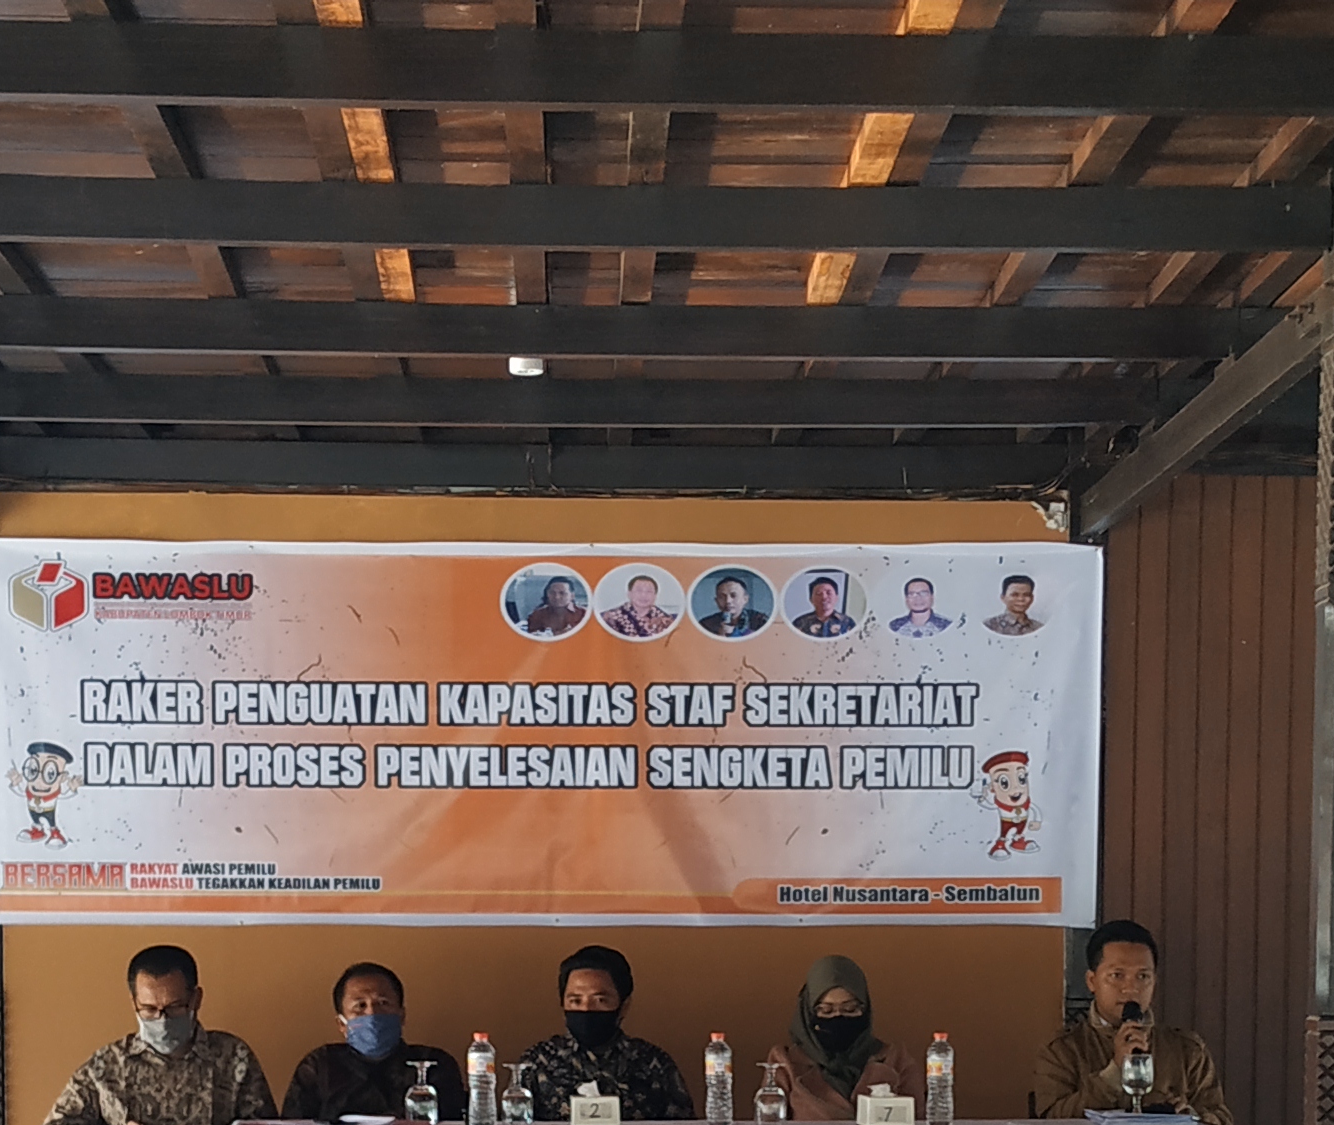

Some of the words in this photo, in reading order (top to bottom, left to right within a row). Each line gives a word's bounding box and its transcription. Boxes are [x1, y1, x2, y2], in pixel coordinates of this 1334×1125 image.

[93, 573, 253, 601] BAWASLU
[81, 680, 203, 723] RAKER
[212, 681, 427, 725] PENGUATAN
[438, 683, 636, 726] KAPASITAS
[645, 684, 735, 726] STAF
[742, 684, 979, 727] SEKRETARIAT
[84, 743, 214, 786] DALAM
[223, 744, 366, 788] PROSES
[375, 744, 638, 788] PENYELESAIAN
[646, 745, 831, 789] SENGKETA
[840, 746, 975, 789] PEMILU
[3, 862, 125, 889] BERSAMA
[130, 863, 179, 876] RAKYAT
[181, 863, 227, 876] AWASI
[229, 864, 277, 876] PEMILU
[130, 877, 194, 890] BAWASLU
[196, 878, 266, 891] TEGAKKAN
[268, 878, 331, 891] KEADILAN
[333, 878, 382, 891] PEMILU
[779, 886, 828, 903] Hotel
[832, 886, 930, 903] Nusantara
[943, 885, 1041, 903] Sembalun
[589, 1102, 602, 1119] 2
[883, 1106, 893, 1122] 7
